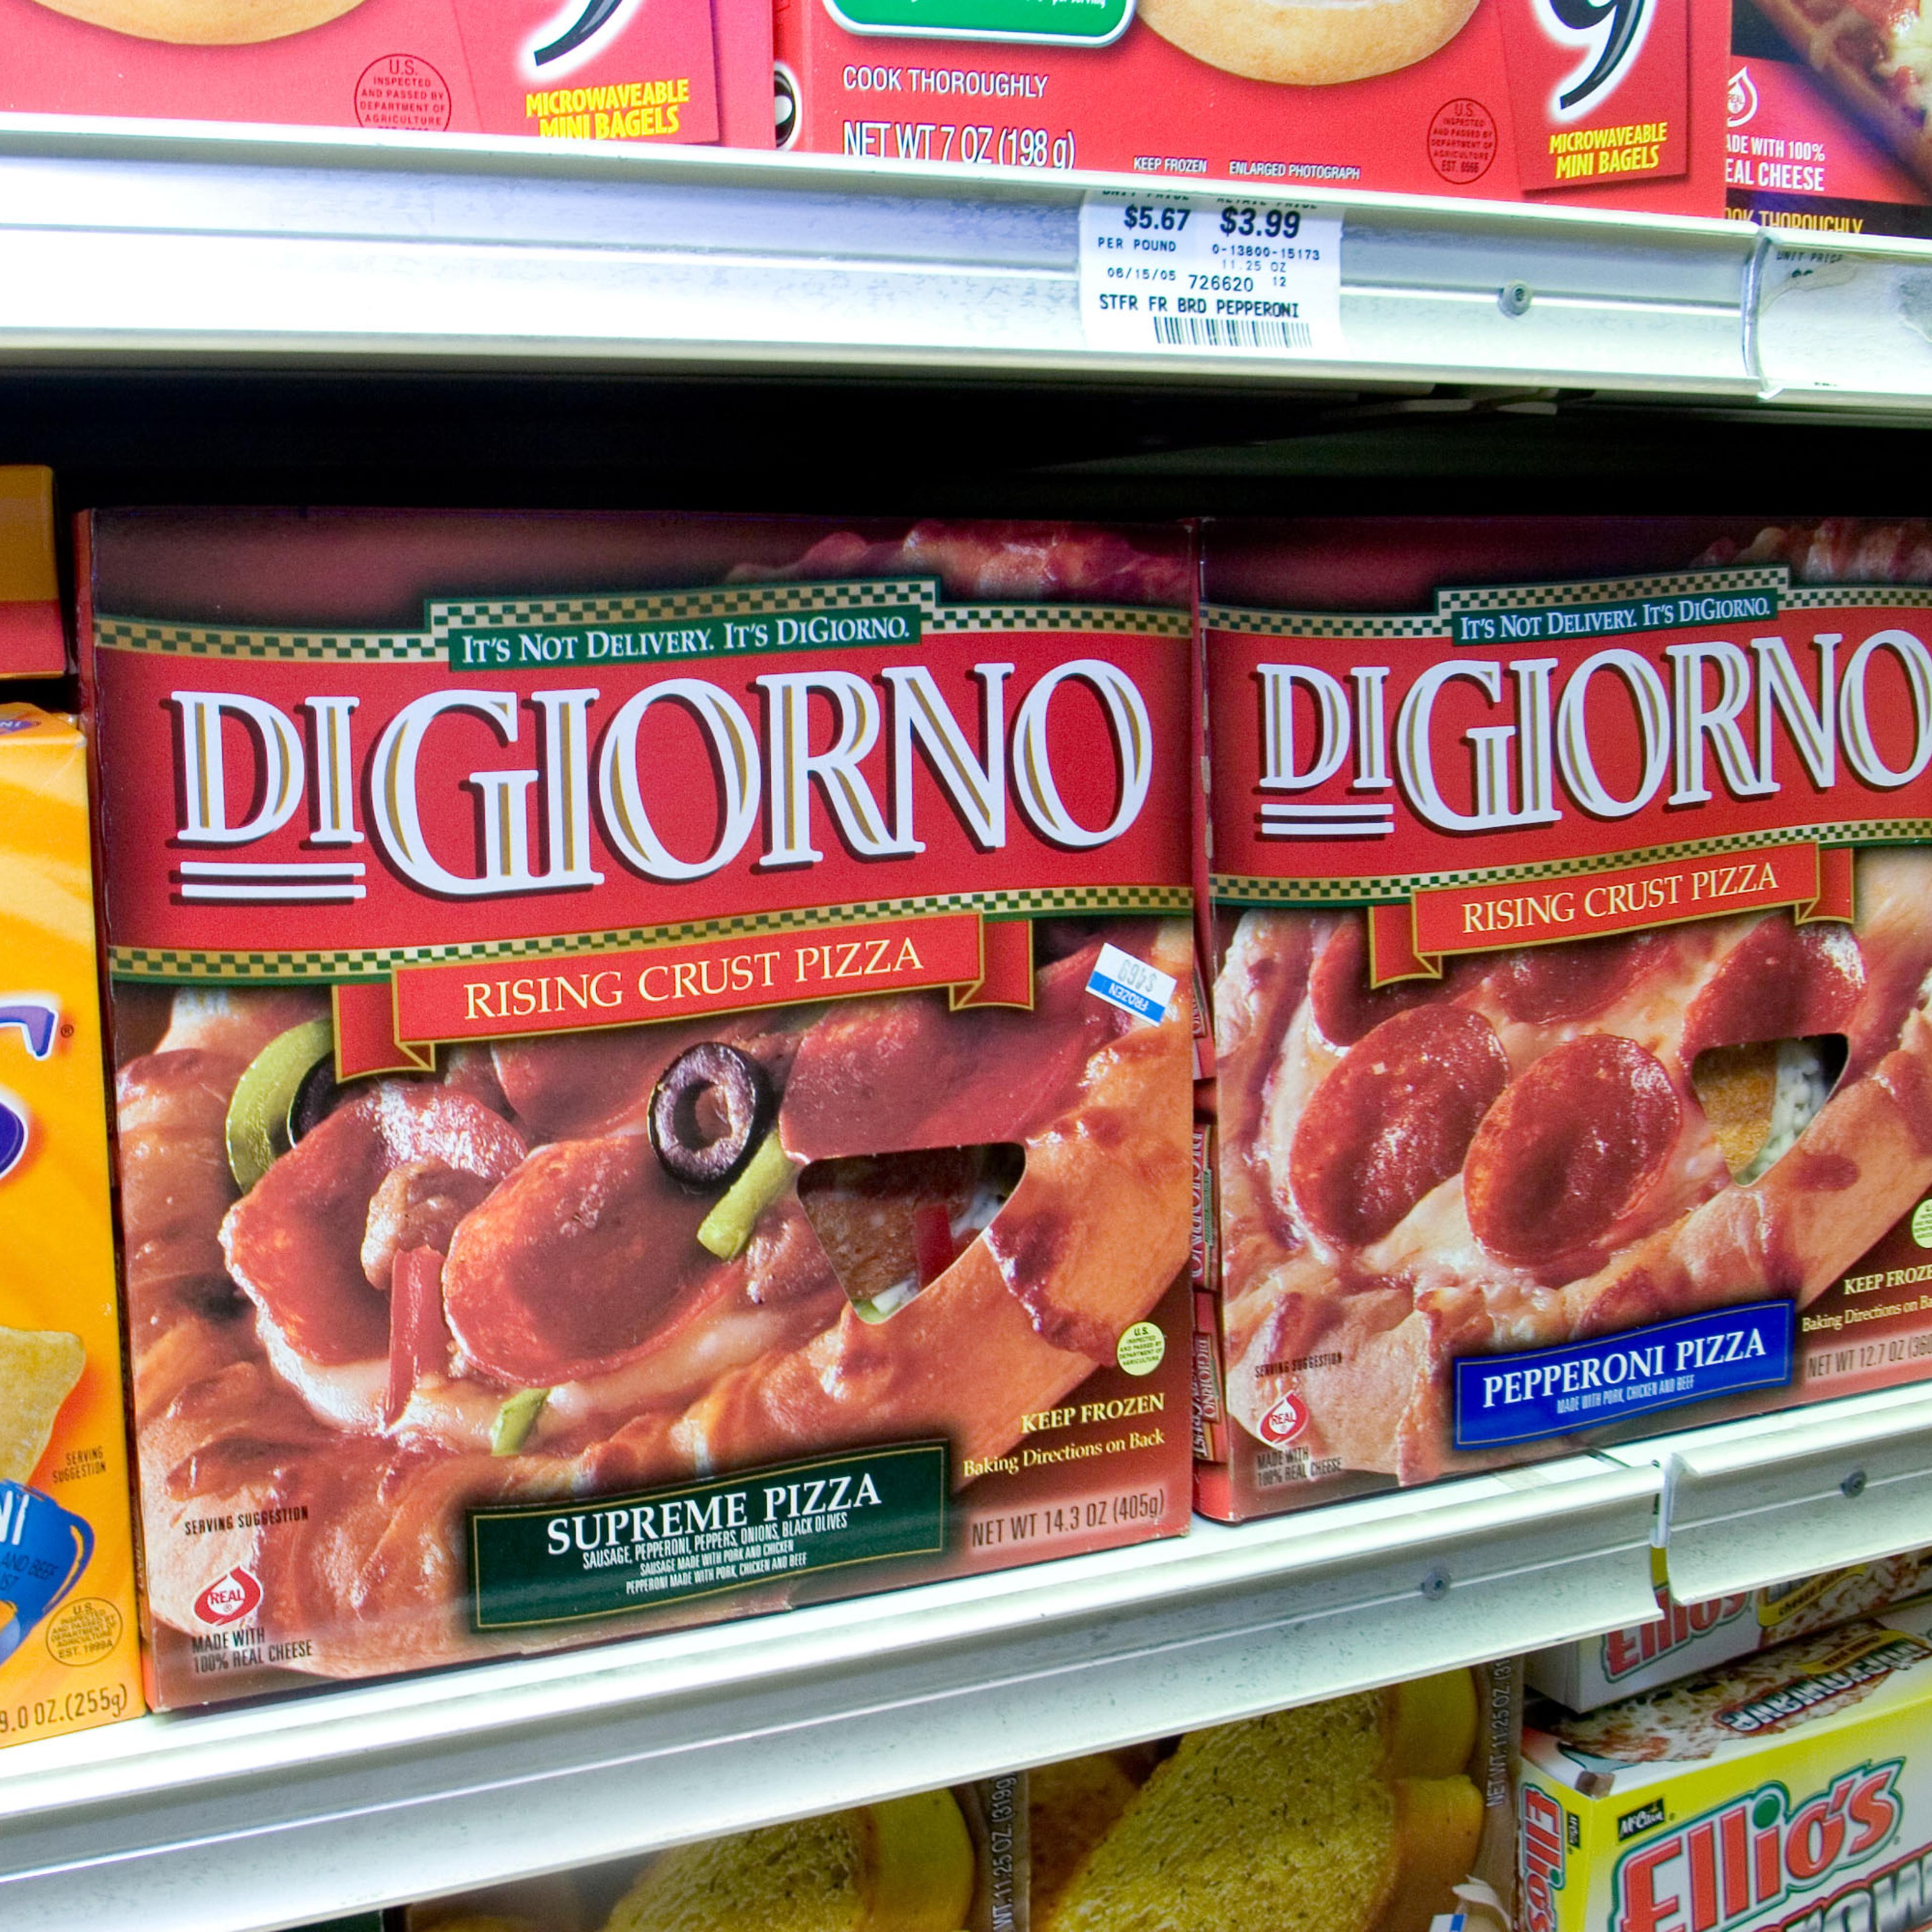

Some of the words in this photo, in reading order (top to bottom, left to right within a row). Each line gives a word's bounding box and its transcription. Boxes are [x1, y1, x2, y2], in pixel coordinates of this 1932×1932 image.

[373, 77, 431, 87] INSPECTED
[389, 59, 418, 75] U.S.
[843, 65, 902, 91] COOK
[908, 68, 1049, 99] THOROUGHLY
[360, 102, 429, 112] DEPARTMENT
[433, 105, 445, 113] OF
[362, 89, 382, 98] AND
[386, 90, 427, 99] PASSED
[526, 79, 690, 118] MICROWAVEABLE
[365, 114, 441, 125] AGRICULTURE
[539, 114, 591, 140] MINI
[595, 105, 679, 140] BAGELS
[843, 121, 891, 159] NET
[896, 124, 936, 162] WT
[940, 126, 955, 162] 7
[960, 126, 993, 164] OZ
[998, 128, 1048, 167] (198
[1549, 122, 1668, 154] MICROWAVEABLE
[1751, 136, 1784, 157] WITH
[1789, 140, 1825, 161] 100%
[1134, 156, 1162, 171] KEEP
[1164, 158, 1207, 173] FROZEN
[1230, 160, 1285, 177] ENLARGED
[1289, 164, 1360, 180] PHOTOGRAPH
[1555, 152, 1594, 179] MINI
[1598, 144, 1660, 174] BAGELS
[1725, 158, 1754, 185] EAL
[1758, 162, 1825, 191] CHEESE
[1124, 204, 1191, 231] $5.67
[1220, 205, 1301, 238] $3.99
[1098, 237, 1122, 249] PER
[1134, 238, 1177, 252] POUND
[1212, 244, 1320, 261] 0-13800-15173
[1222, 259, 1261, 271] 11.25
[1270, 262, 1286, 272] OZ
[1188, 274, 1254, 292] 726620
[1273, 276, 1286, 287] 12
[1099, 294, 1138, 310] STFR
[1149, 296, 1167, 311] FR
[1178, 297, 1206, 313] BRD
[1217, 299, 1299, 318] PEPPERONI
[1462, 892, 1575, 933] RISING
[1584, 875, 1683, 916] CRUST
[1691, 862, 1779, 901] PIZZA
[464, 971, 623, 1020] RISING
[638, 951, 780, 1002] CRUST
[795, 937, 924, 983] PIZZA
[1108, 982, 1150, 1012] FROZEN
[1843, 1273, 1884, 1295] KEEP
[1886, 1264, 1932, 1287] FROZE
[1802, 1314, 1843, 1332] Baking
[1844, 1304, 1901, 1324] Directions
[1903, 1301, 1918, 1313] on
[1255, 1361, 1290, 1378] SERVING
[1291, 1352, 1342, 1372] SUGGESTION
[1482, 1346, 1665, 1408] PEPPERONI
[1675, 1328, 1766, 1372] PIZZA
[1808, 1354, 1831, 1378] NET
[1835, 1349, 1855, 1373] WT
[1860, 1343, 1885, 1369] 12.7
[1889, 1339, 1905, 1362] OZ
[1020, 1409, 1076, 1434] KEEP
[1081, 1393, 1165, 1423] FROZEN
[1271, 1413, 1296, 1425] REAL
[65, 1446, 104, 1466] SERVING
[962, 1453, 1019, 1478] Baking
[1023, 1438, 1102, 1468] Directions
[1106, 1440, 1126, 1455] on
[1129, 1428, 1165, 1450] Back
[1257, 1451, 1283, 1468] MADE
[1285, 1463, 1308, 1480] REAL
[1310, 1457, 1342, 1477] CHEESE
[53, 1462, 106, 1483] SUGGESTION
[185, 1515, 234, 1536] SERVING
[238, 1505, 309, 1528] SUGGESTION
[547, 1492, 748, 1556] SUPREME
[763, 1473, 881, 1521] PIZZA
[972, 1519, 1004, 1547] NET
[1011, 1513, 1037, 1540] WT
[1044, 1506, 1080, 1533] 14.3
[1087, 1501, 1107, 1526] OZ
[1112, 1488, 1164, 1524] (405g)
[582, 1546, 632, 1570] SAUSAGE,
[635, 1537, 692, 1561] PEPPERONI,
[694, 1530, 738, 1552] PEPPERS,
[741, 1523, 780, 1545] ONIONS,
[782, 1518, 813, 1538] BLACK
[815, 1511, 848, 1532] OLIVES
[626, 1577, 669, 1595] PEPPERONI
[670, 1573, 692, 1588] MADE
[693, 1569, 714, 1585] WITH
[739, 1560, 771, 1576] CHICKEN
[771, 1556, 787, 1571] AND
[789, 1552, 808, 1568] BEEF
[640, 1558, 676, 1577] SAUSAGE
[677, 1554, 701, 1571] MADE
[702, 1551, 722, 1567] WITH
[723, 1548, 744, 1563] PORK
[745, 1544, 761, 1559] AND
[763, 1539, 793, 1556] CHICKEN
[210, 1588, 245, 1605] REAL
[192, 1631, 229, 1653] MADE
[232, 1627, 265, 1647] WITH
[195, 1653, 229, 1673] 100%
[233, 1648, 264, 1668] REAL
[269, 1639, 312, 1662] CHEESE
[1486, 1780, 1505, 1808] NET
[1620, 1770, 1899, 1932] Ellio's
